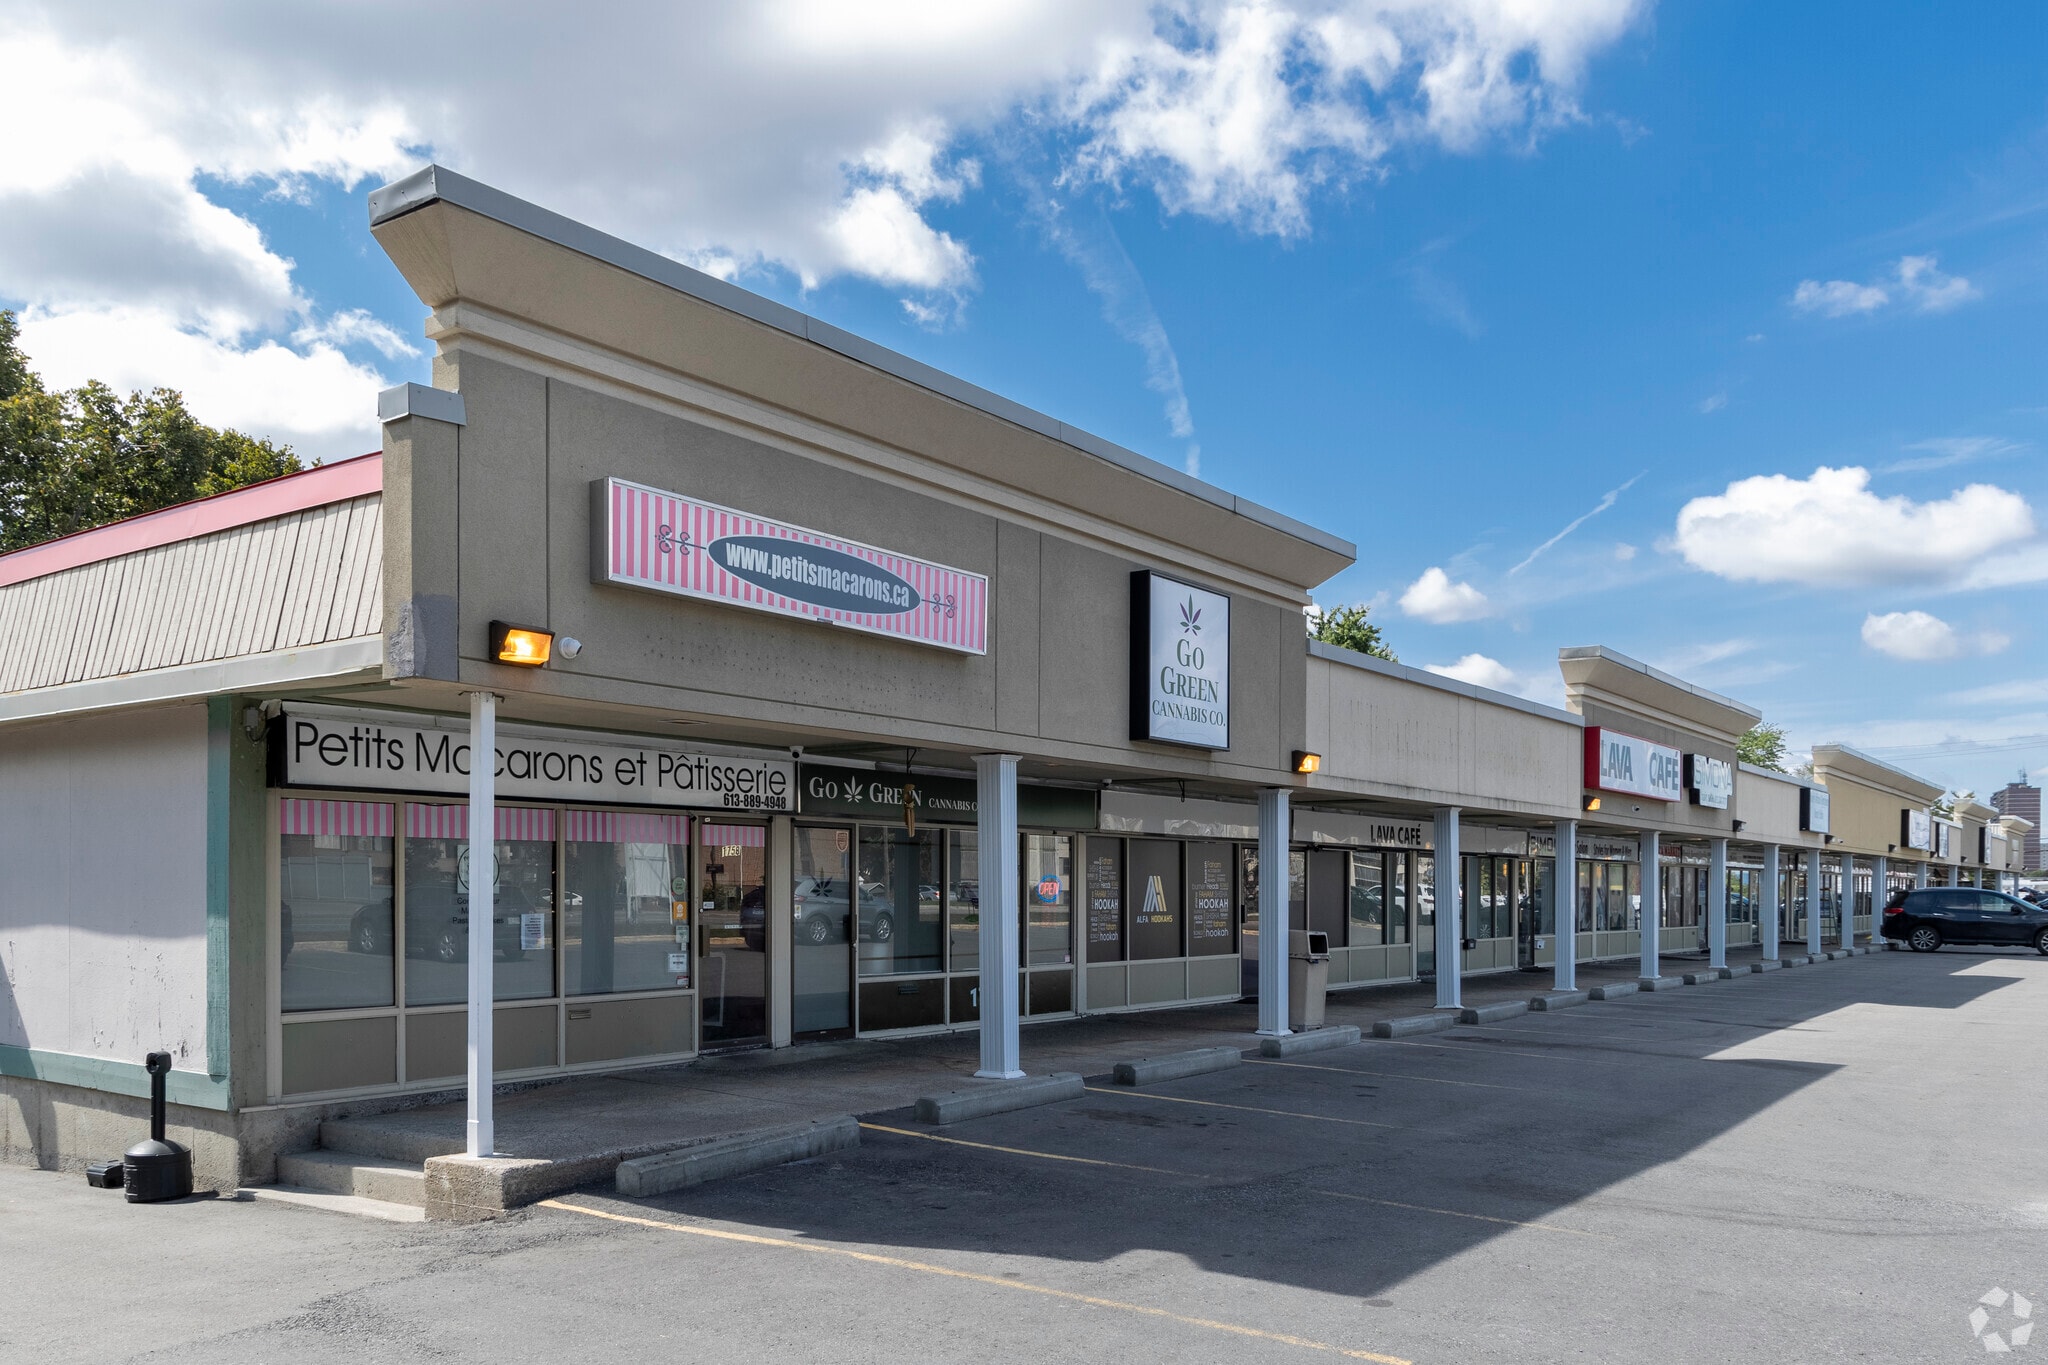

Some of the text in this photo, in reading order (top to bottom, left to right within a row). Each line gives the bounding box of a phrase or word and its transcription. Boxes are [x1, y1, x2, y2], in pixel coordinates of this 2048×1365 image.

[724, 541, 910, 608] www.petitsmacarons.ca
[1160, 665, 1219, 704] GREEN
[1152, 699, 1226, 727] CANNABIS CO.
[295, 720, 405, 772] Petits
[615, 750, 647, 787] et
[658, 753, 787, 797] Pâtisserie
[1600, 739, 1679, 792] LAVA CAFÉ
[722, 793, 788, 811] 613-889-4948
[869, 782, 923, 807] GREN
[928, 797, 971, 811] CANNABIS
[1370, 824, 1422, 846] LAVA CAFÉ
[1530, 836, 1557, 852] SIMO
[1039, 881, 1060, 896] OPEN
[1094, 899, 1119, 910] HOOKAH
[1198, 898, 1229, 909] HOOKAH
[1136, 914, 1173, 924] ALFA HOOKAHS
